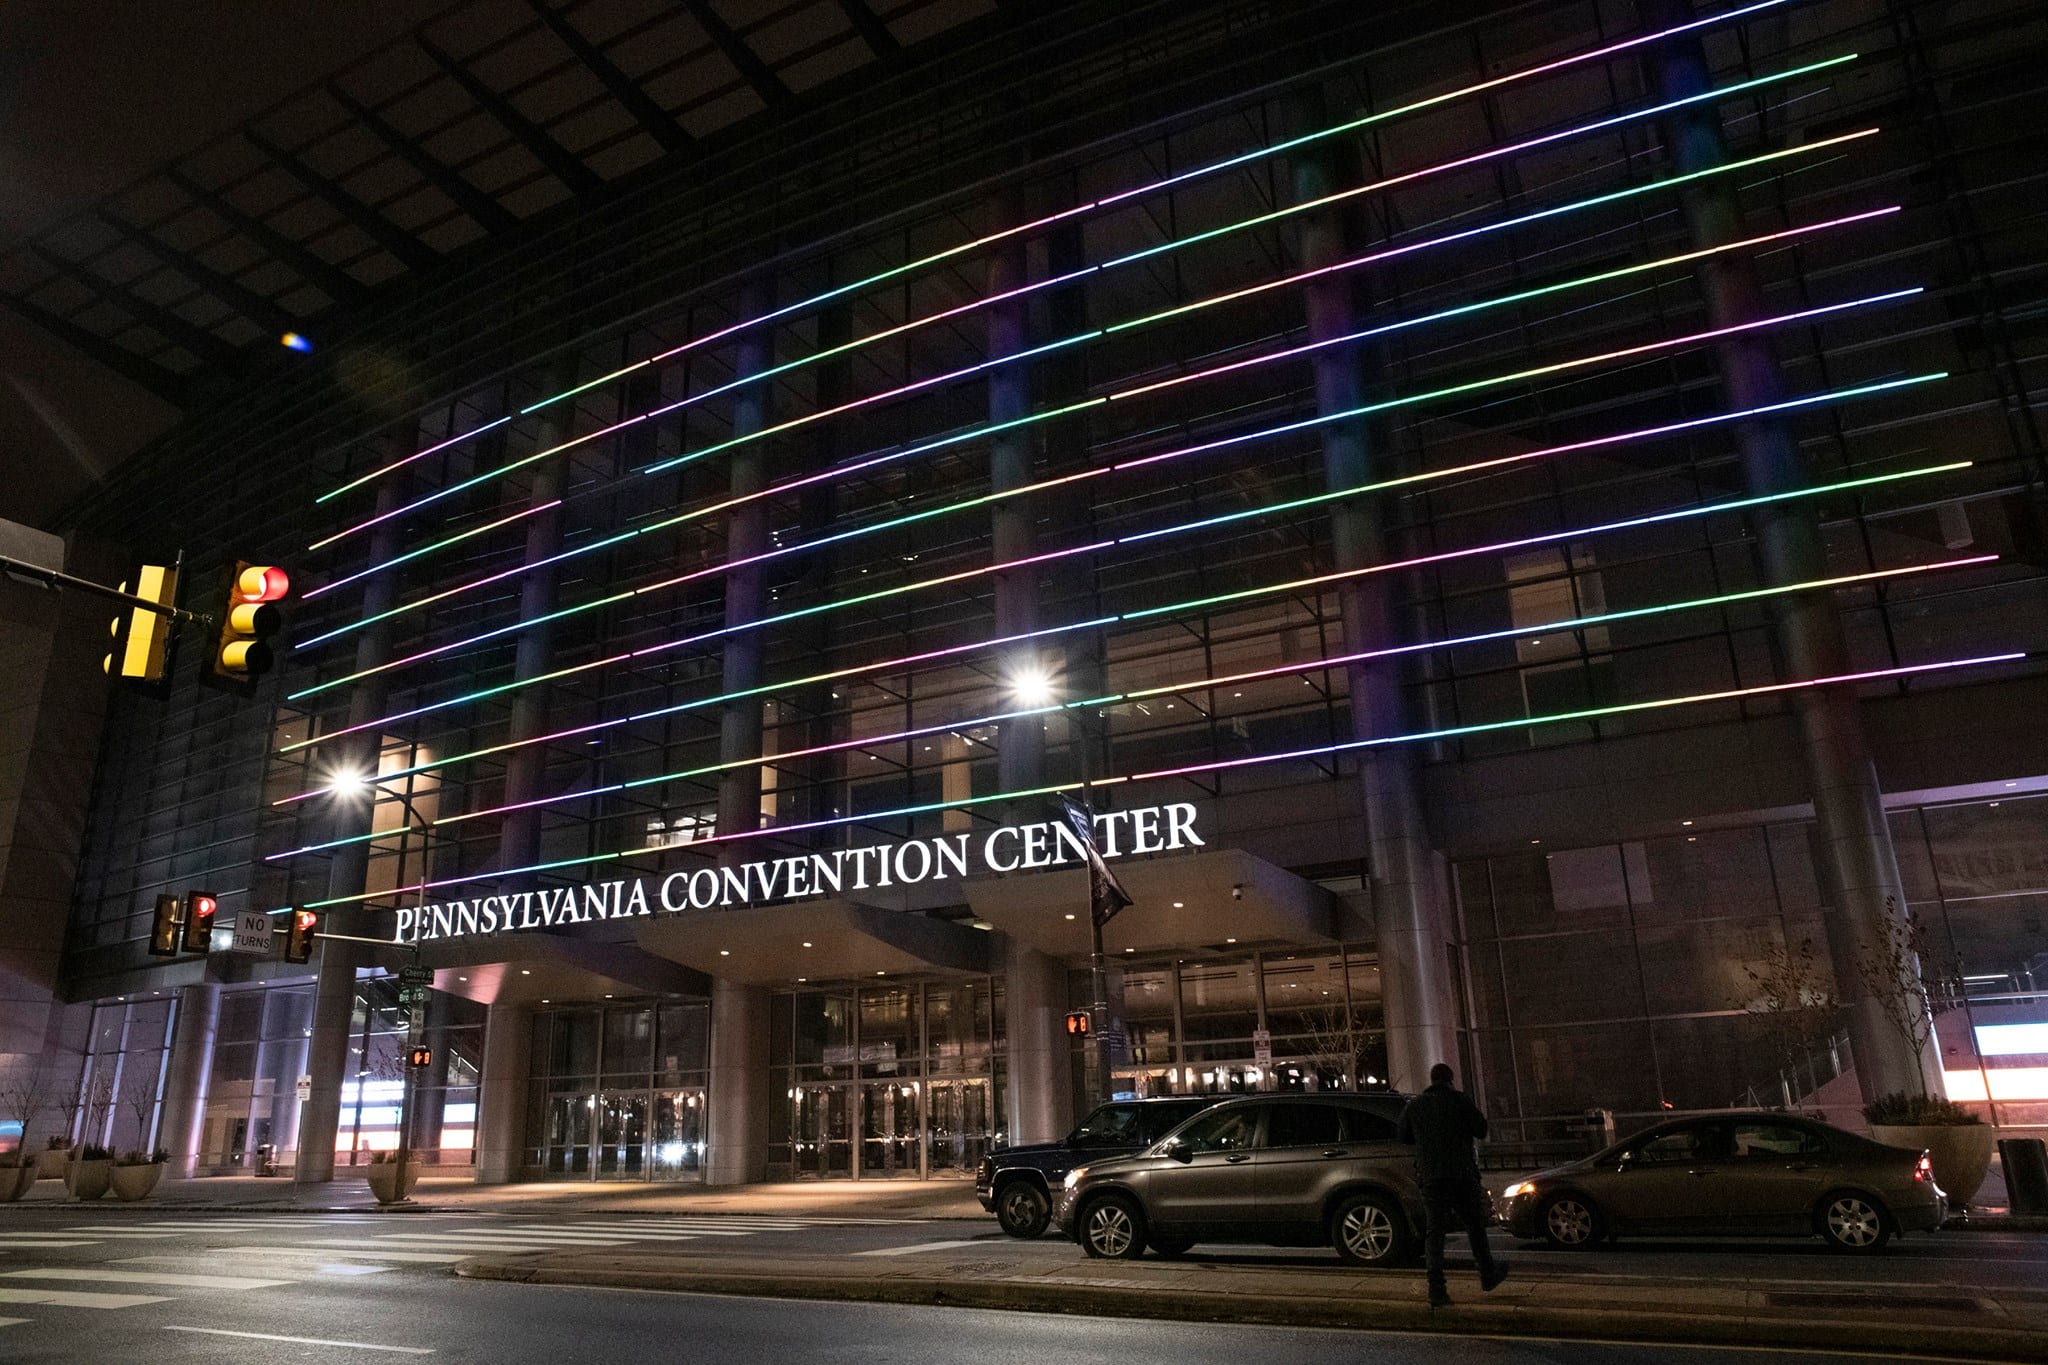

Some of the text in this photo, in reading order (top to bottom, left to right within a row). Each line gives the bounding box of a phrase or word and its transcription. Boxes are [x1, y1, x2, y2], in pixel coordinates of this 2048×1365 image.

[393, 802, 1206, 944] PENNSYLVANIA CONVENTION CENTER
[245, 916, 265, 932] NO
[236, 934, 270, 949] TURNS
[404, 968, 426, 978] Cherry
[399, 992, 424, 1002] Brod St
